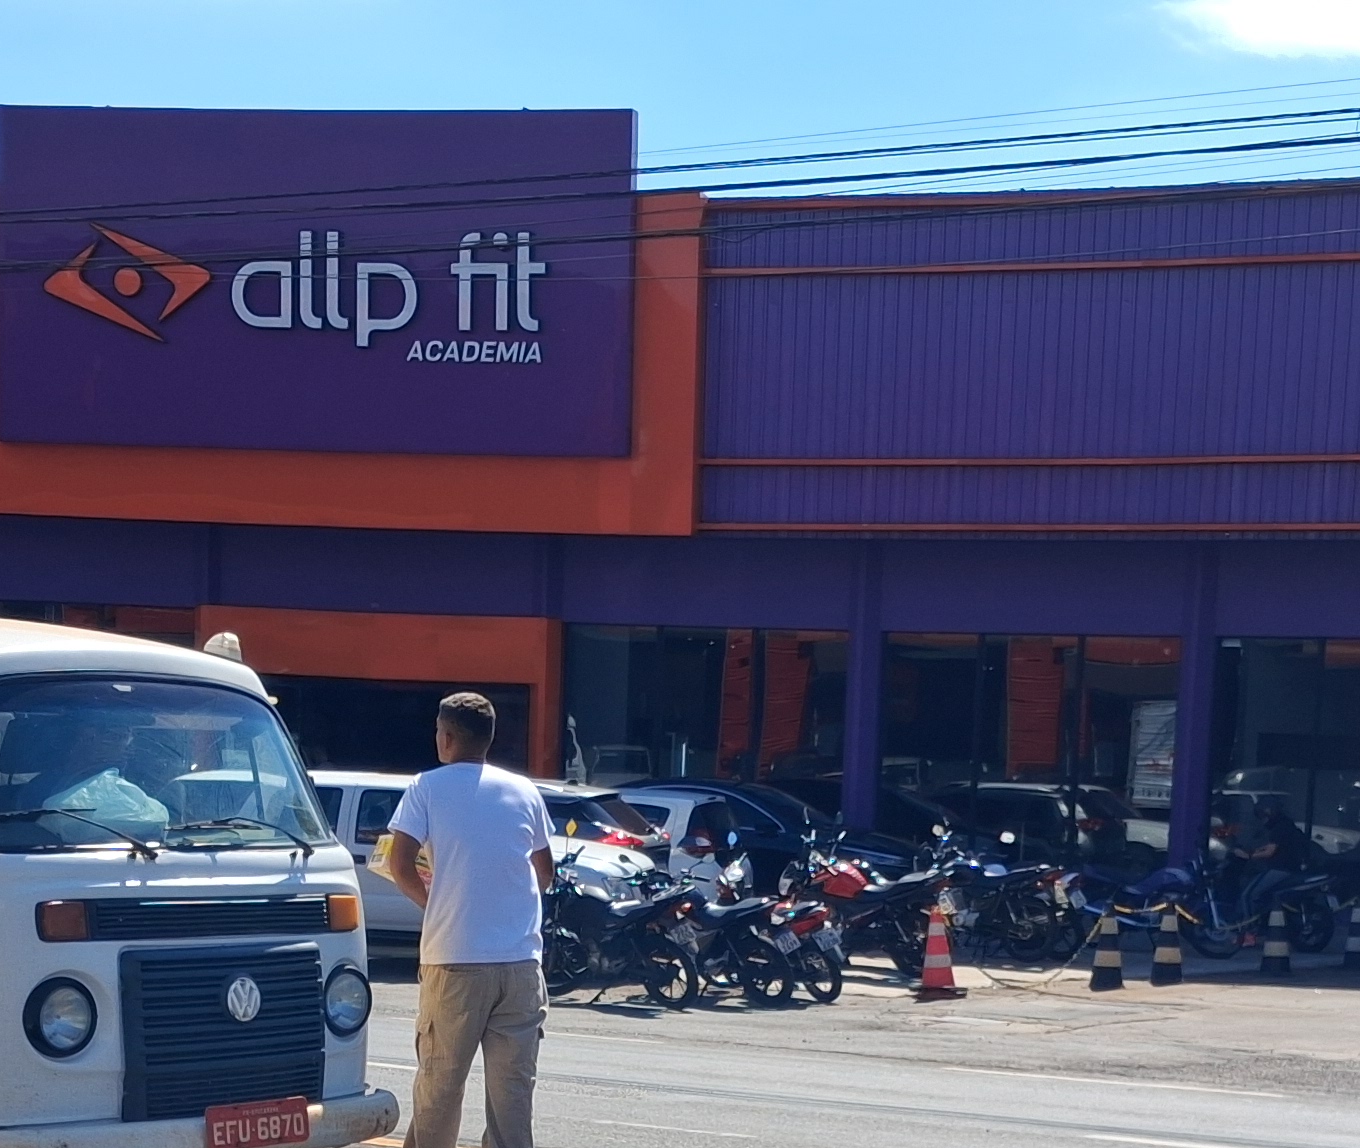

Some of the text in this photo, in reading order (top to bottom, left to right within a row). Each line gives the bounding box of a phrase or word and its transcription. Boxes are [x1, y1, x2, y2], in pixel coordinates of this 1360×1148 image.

[231, 231, 546, 347] allp fit
[406, 341, 542, 364] ACADEMIA
